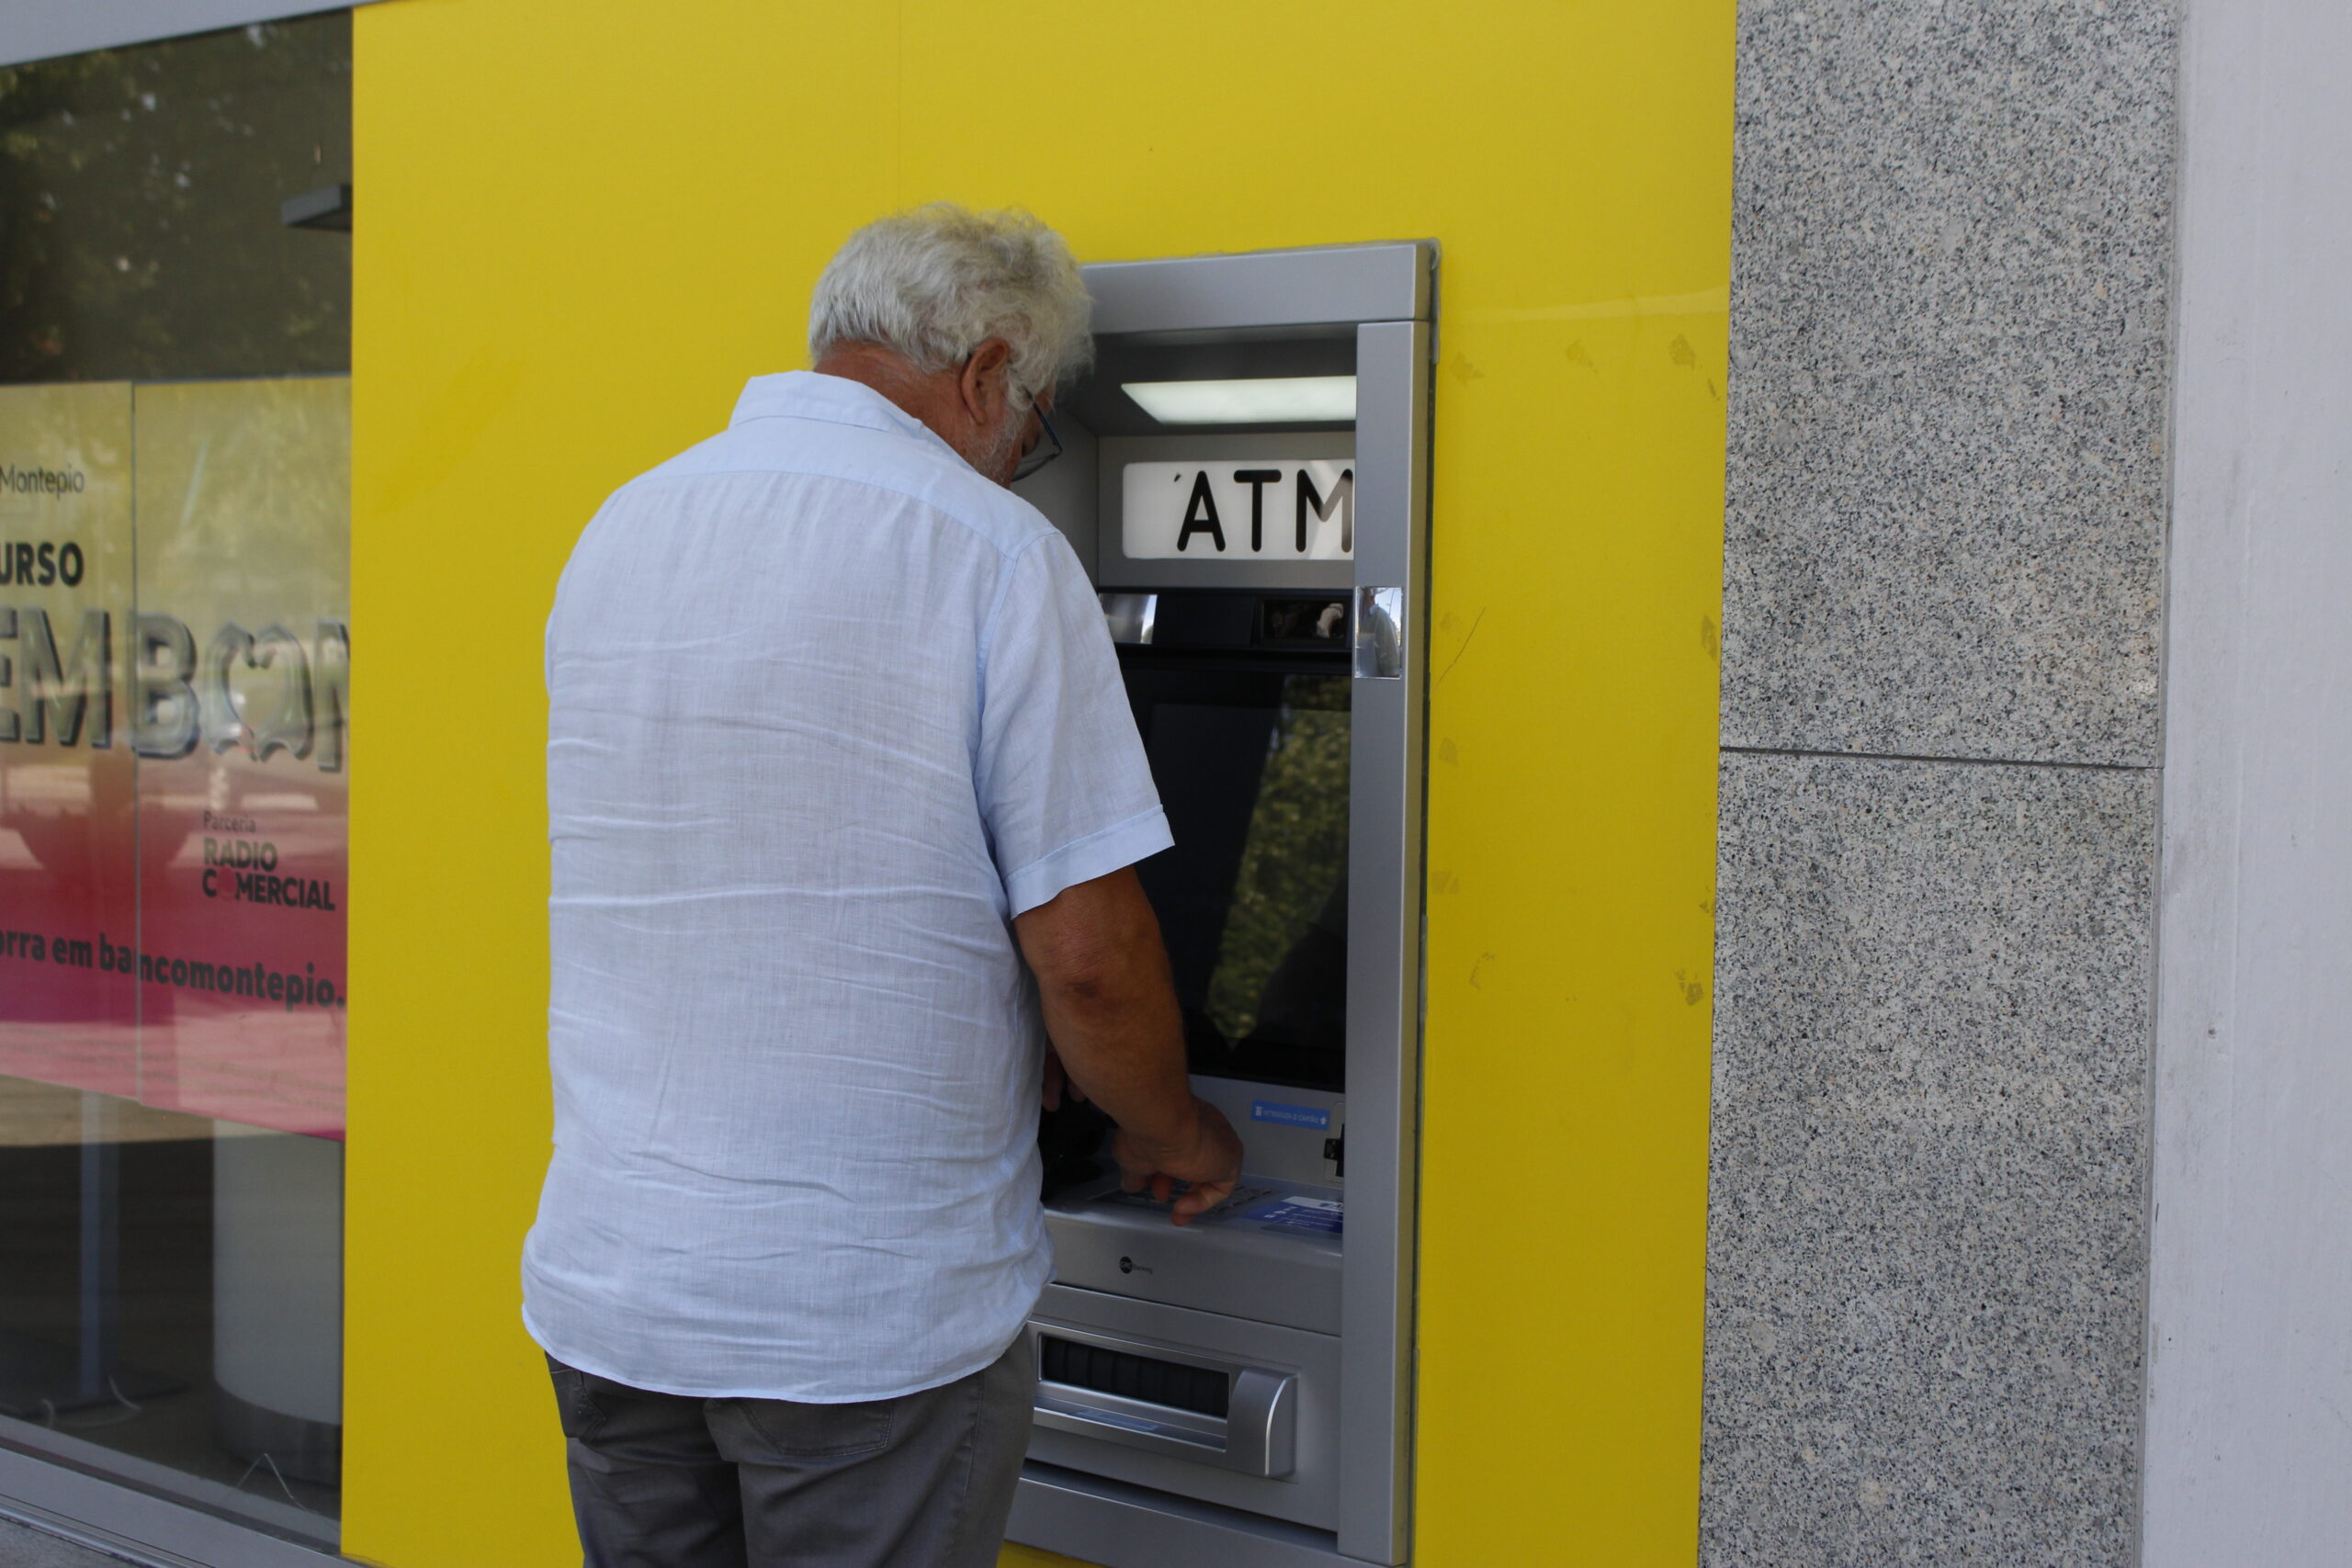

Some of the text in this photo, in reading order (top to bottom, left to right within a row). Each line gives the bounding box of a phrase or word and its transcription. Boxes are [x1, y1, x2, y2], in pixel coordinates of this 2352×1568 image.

[1177, 468, 1353, 553] ATM
[203, 809, 256, 833] Parceria
[203, 837, 278, 872] RADIO
[0, 930, 345, 1013] rra em bancomontepio.
